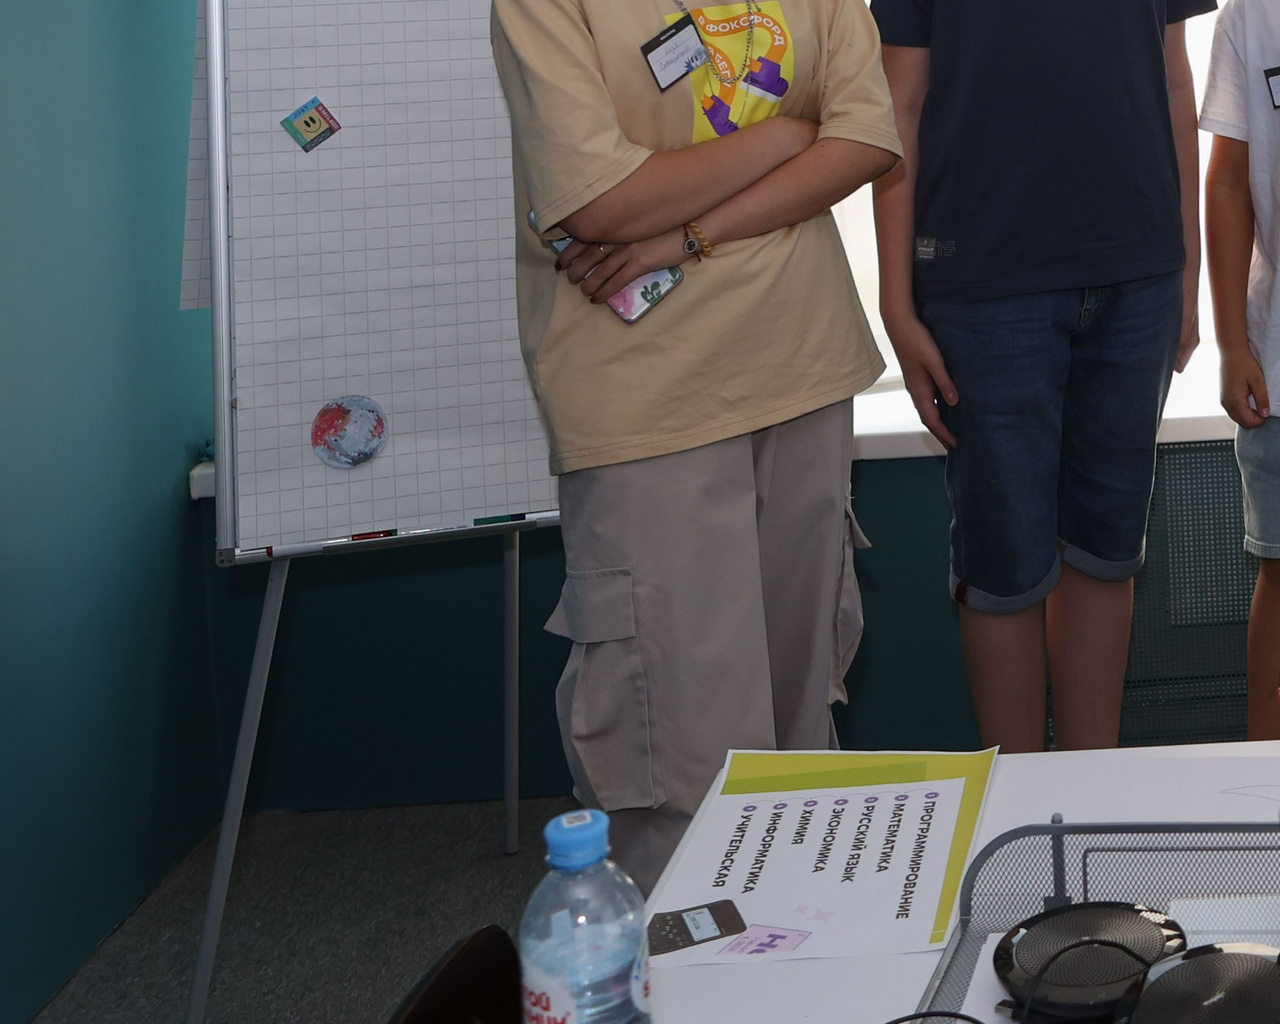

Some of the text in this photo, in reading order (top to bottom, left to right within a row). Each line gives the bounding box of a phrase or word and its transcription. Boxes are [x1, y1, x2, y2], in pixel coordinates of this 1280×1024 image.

[712, 813, 754, 888] УЧИТЕЛЬСКАЯ
[740, 811, 784, 894] ИНФОРМАТИКА
[790, 808, 815, 845] ХИМИЯ
[811, 808, 845, 873] ЭКОНОМИКА
[850, 805, 876, 851] РУССКИЙ
[875, 803, 906, 873] МАТЕМАТИКА
[895, 800, 937, 920] ПРОГРАММИРОВАНИЕ
[840, 852, 861, 883] ЯЗЫК
